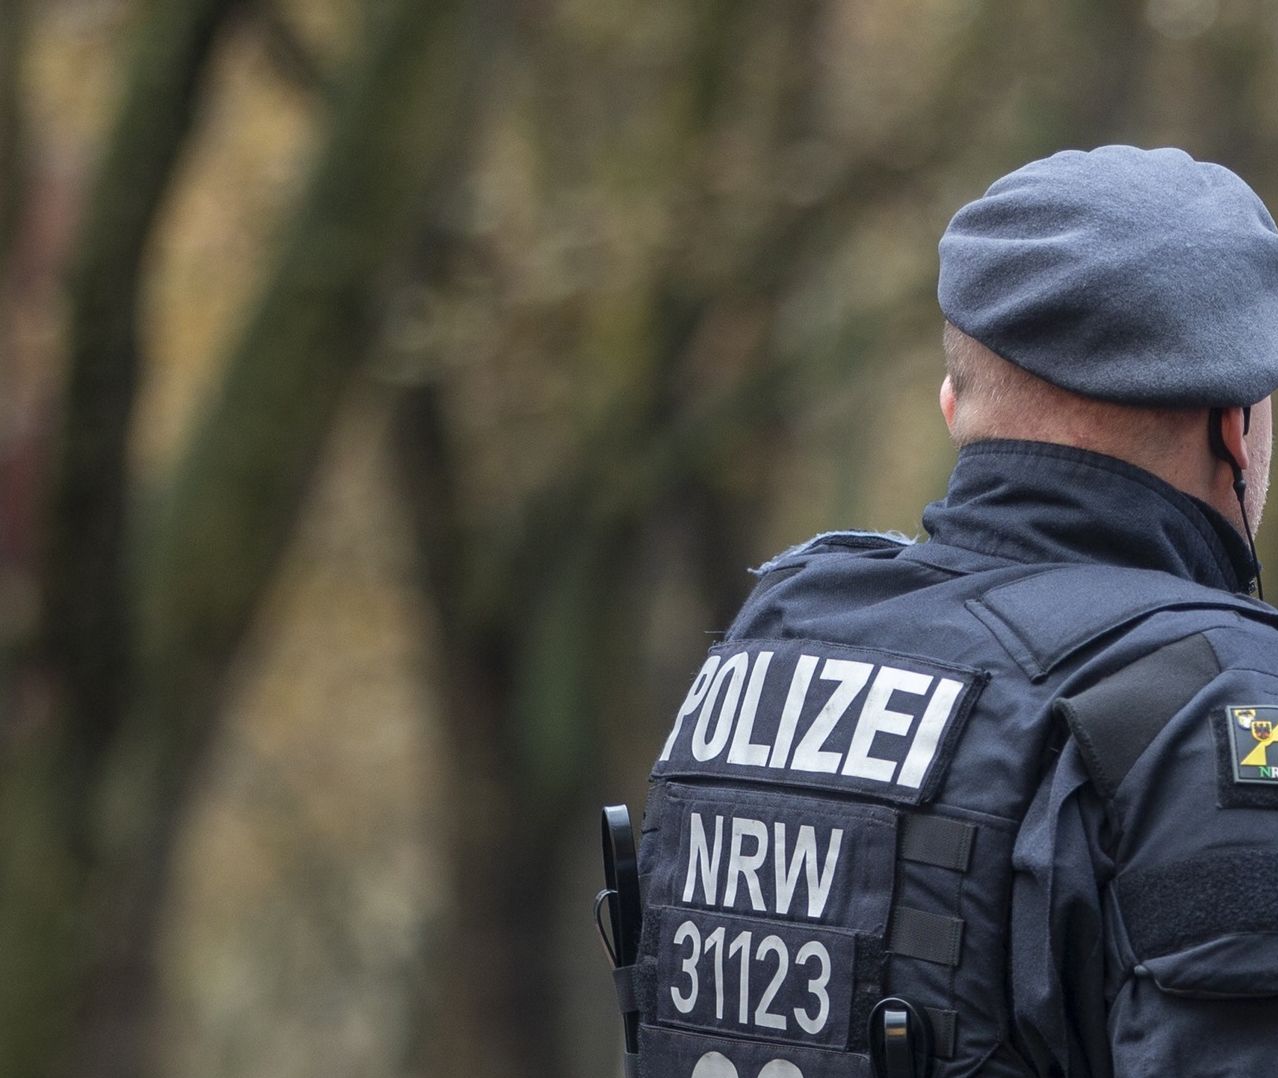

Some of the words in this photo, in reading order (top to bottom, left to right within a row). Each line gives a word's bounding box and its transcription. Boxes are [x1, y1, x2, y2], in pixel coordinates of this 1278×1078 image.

[658, 651, 963, 788] POLIZEI
[681, 812, 844, 918] NRW
[670, 920, 832, 1034] 31123
